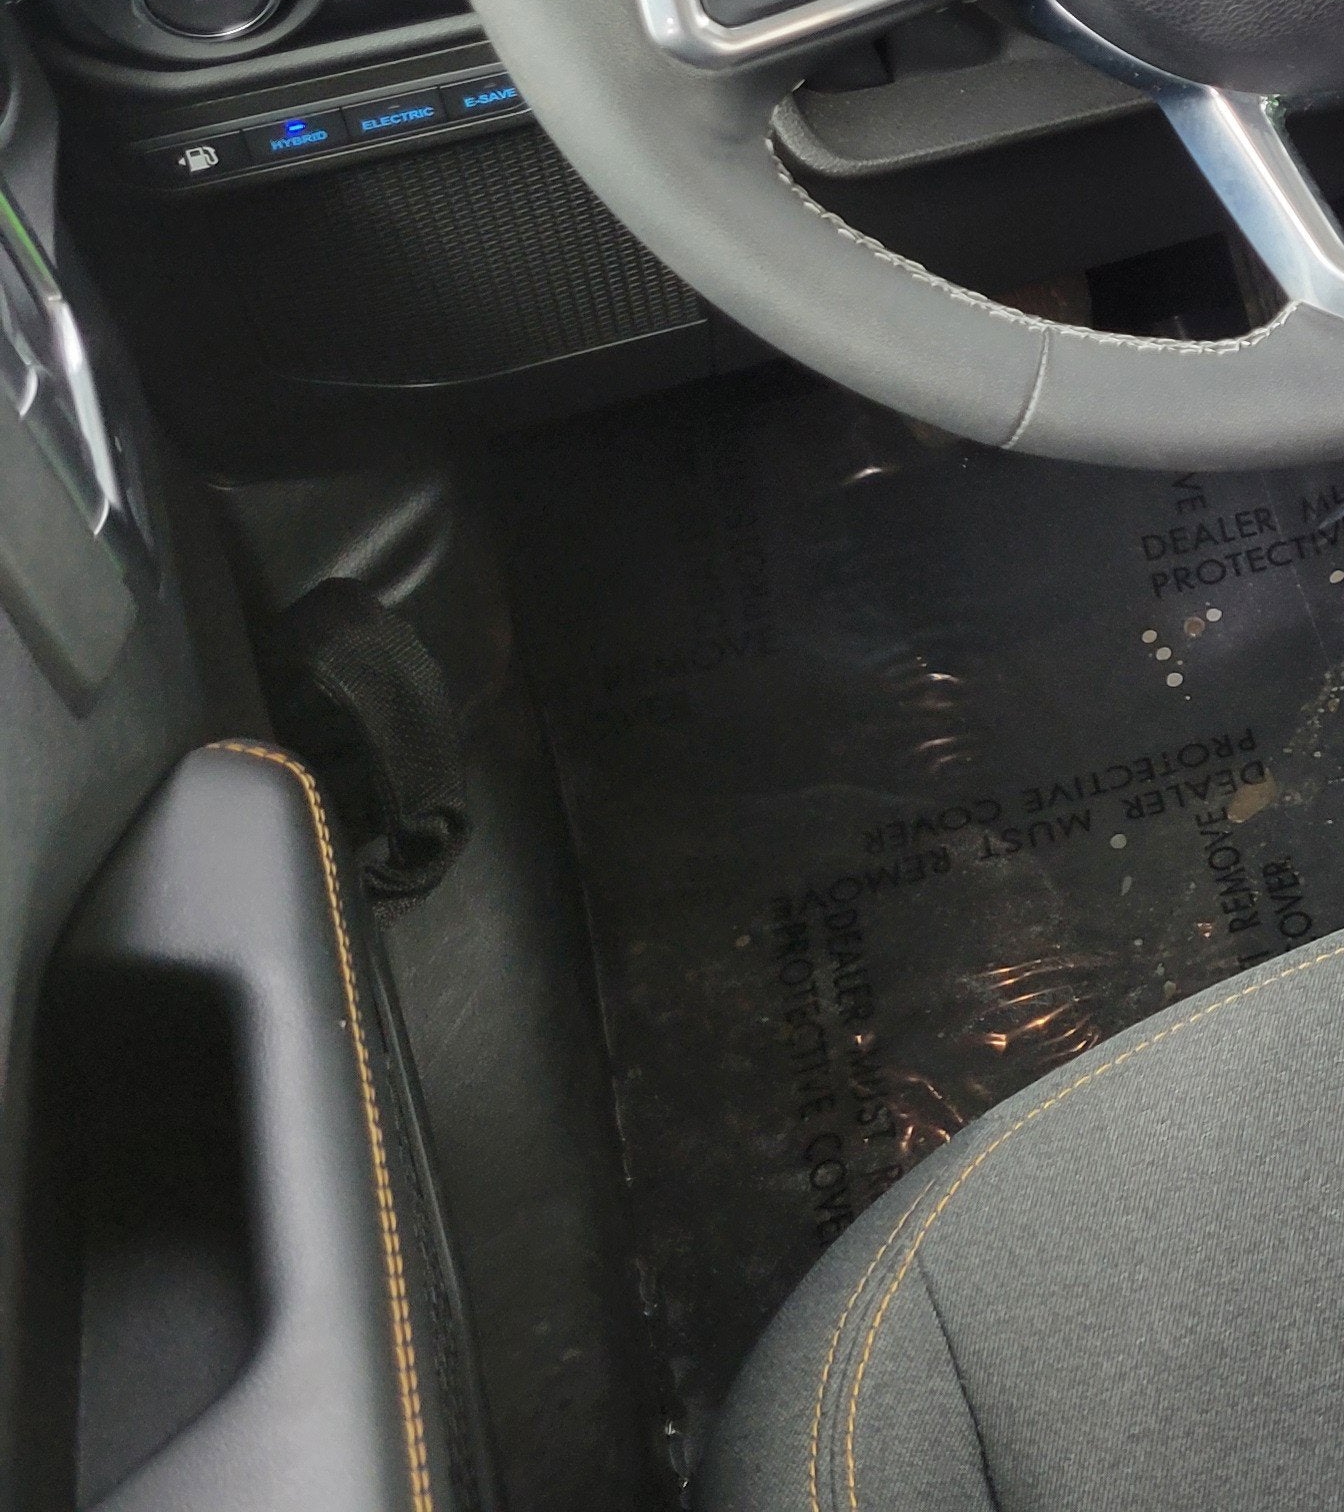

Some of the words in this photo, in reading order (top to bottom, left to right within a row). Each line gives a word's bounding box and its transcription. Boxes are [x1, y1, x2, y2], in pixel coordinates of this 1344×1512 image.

[270, 128, 329, 150] HYBRID
[361, 104, 436, 132] ELECTRIC
[1140, 505, 1277, 562] DEALER
[1021, 726, 1257, 815] PROTECTIVE
[1119, 758, 1266, 821] DEALER
[863, 797, 1002, 855] COVER
[979, 807, 1093, 862] MUST
[1195, 805, 1263, 935] REMOVE
[1261, 853, 1314, 952] OVER
[803, 1130, 853, 1251] COVE
